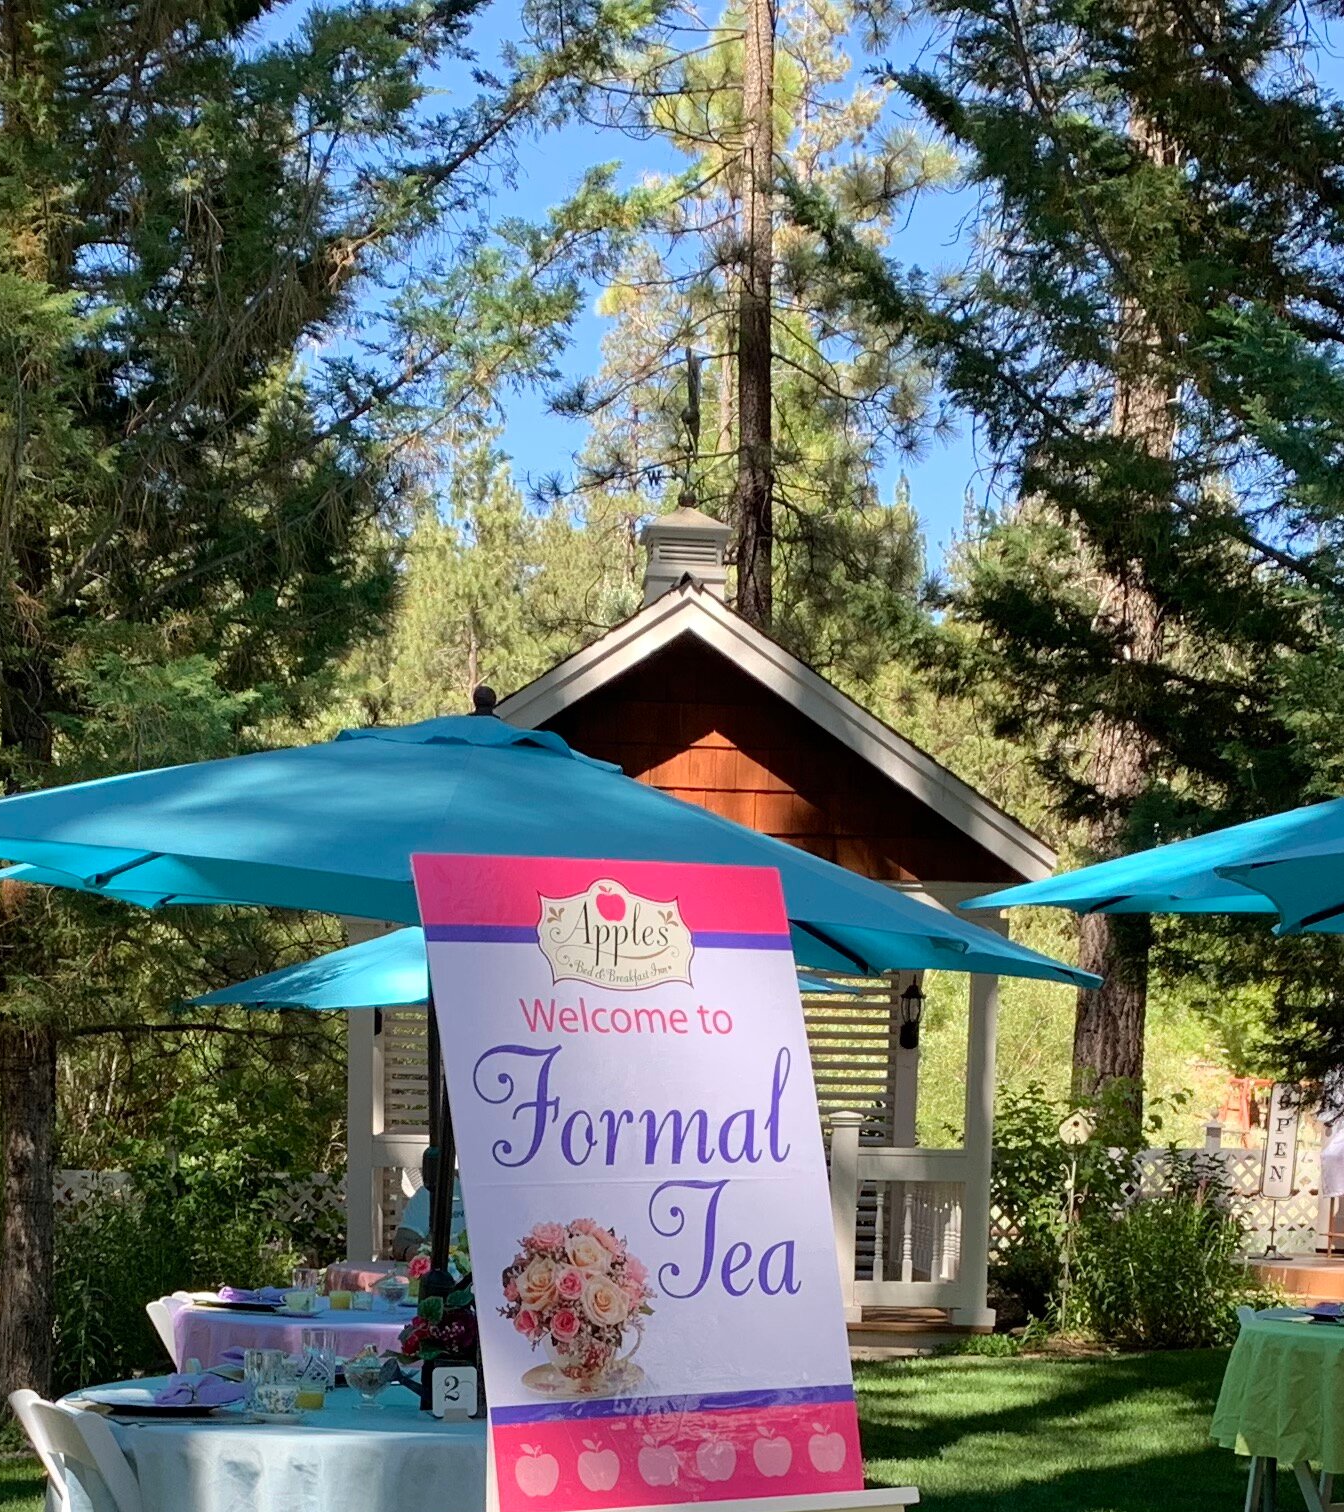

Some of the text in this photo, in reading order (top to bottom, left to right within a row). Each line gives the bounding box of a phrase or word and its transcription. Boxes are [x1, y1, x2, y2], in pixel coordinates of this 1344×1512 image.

[550, 901, 669, 966] Apples
[574, 960, 668, 986] Bed & Breakfast Inn
[520, 998, 733, 1035] Welcome to
[473, 1044, 791, 1168] Formal
[649, 1179, 801, 1300] Tea
[444, 1375, 460, 1402] 2
